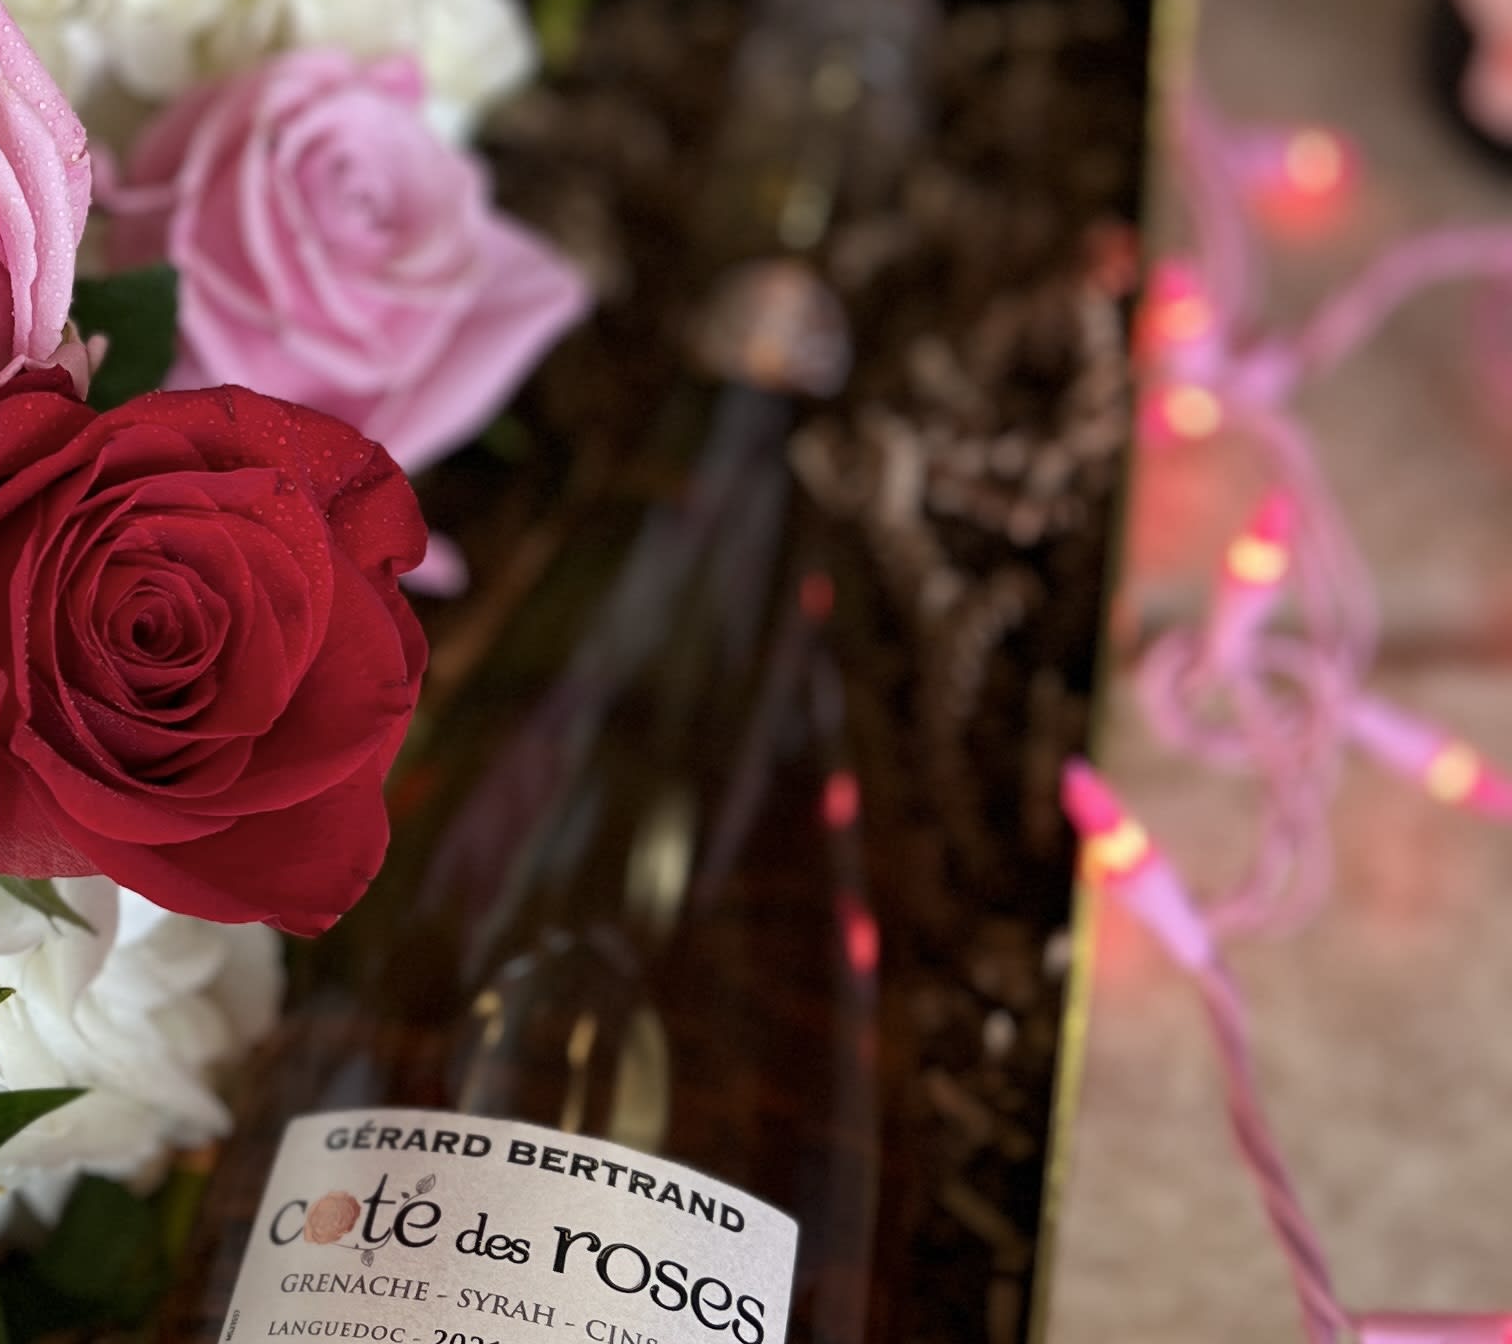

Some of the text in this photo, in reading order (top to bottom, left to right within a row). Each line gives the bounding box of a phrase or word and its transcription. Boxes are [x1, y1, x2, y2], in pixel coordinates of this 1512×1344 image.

[325, 1120, 745, 1233] GÉRARD BERTRAND
[455, 1212, 531, 1264] des
[280, 1273, 430, 1302] GRENACHE
[456, 1288, 557, 1327] SYRAH
[267, 1320, 407, 1343] LANGUEDOC
